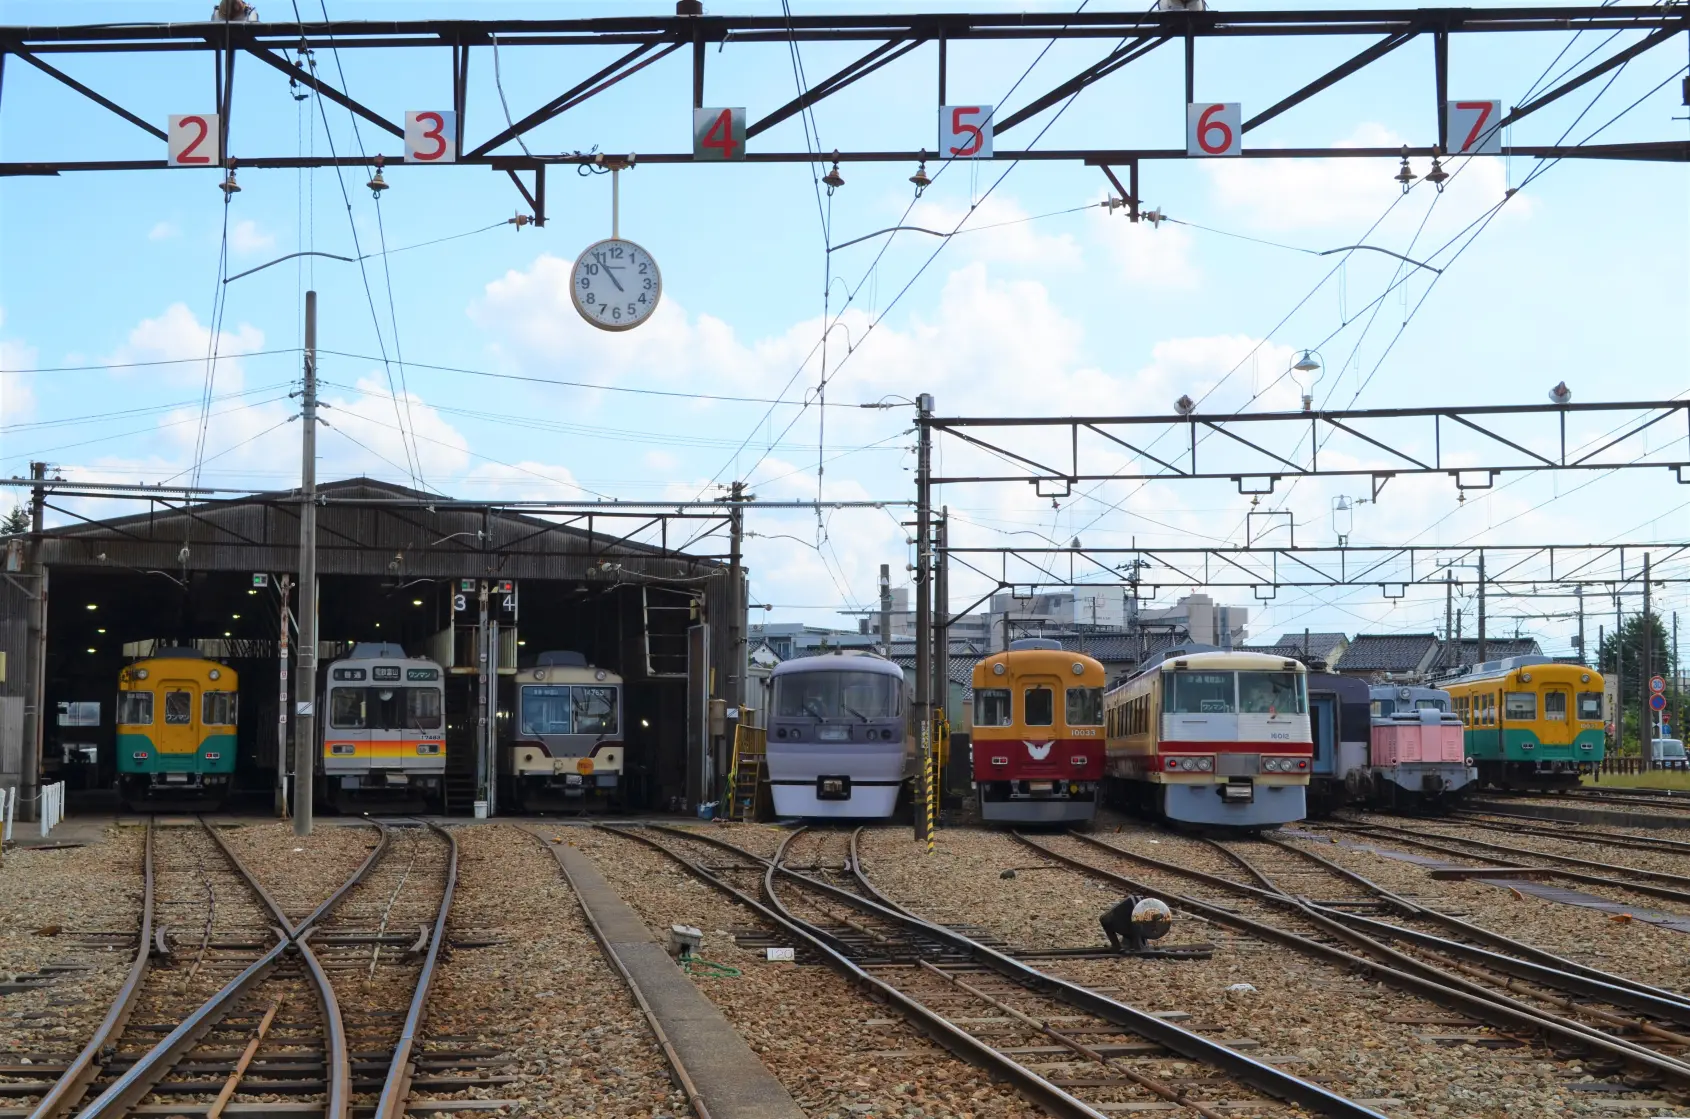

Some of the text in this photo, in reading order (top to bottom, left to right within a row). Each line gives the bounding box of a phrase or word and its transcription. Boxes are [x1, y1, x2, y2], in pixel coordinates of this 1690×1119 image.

[951, 108, 981, 155] 5
[1198, 106, 1231, 153] 6
[1459, 103, 1491, 148] 7
[178, 117, 209, 162] 2
[415, 113, 446, 159] 3
[703, 110, 736, 157] 4
[608, 247, 624, 259] 12
[629, 252, 635, 264] 1
[584, 263, 599, 275] 10
[638, 262, 648, 275] 2
[580, 277, 590, 290] 9
[643, 278, 652, 290] 3
[586, 292, 596, 304] 8
[637, 292, 647, 305] 4
[598, 304, 608, 315] 7
[612, 307, 621, 319] 6
[627, 303, 636, 315] 5
[454, 594, 466, 611] 3
[503, 594, 515, 611] 4
[408, 671, 431, 679] ワンマン
[1071, 729, 1096, 737] 10033
[771, 949, 793, 960] 120
